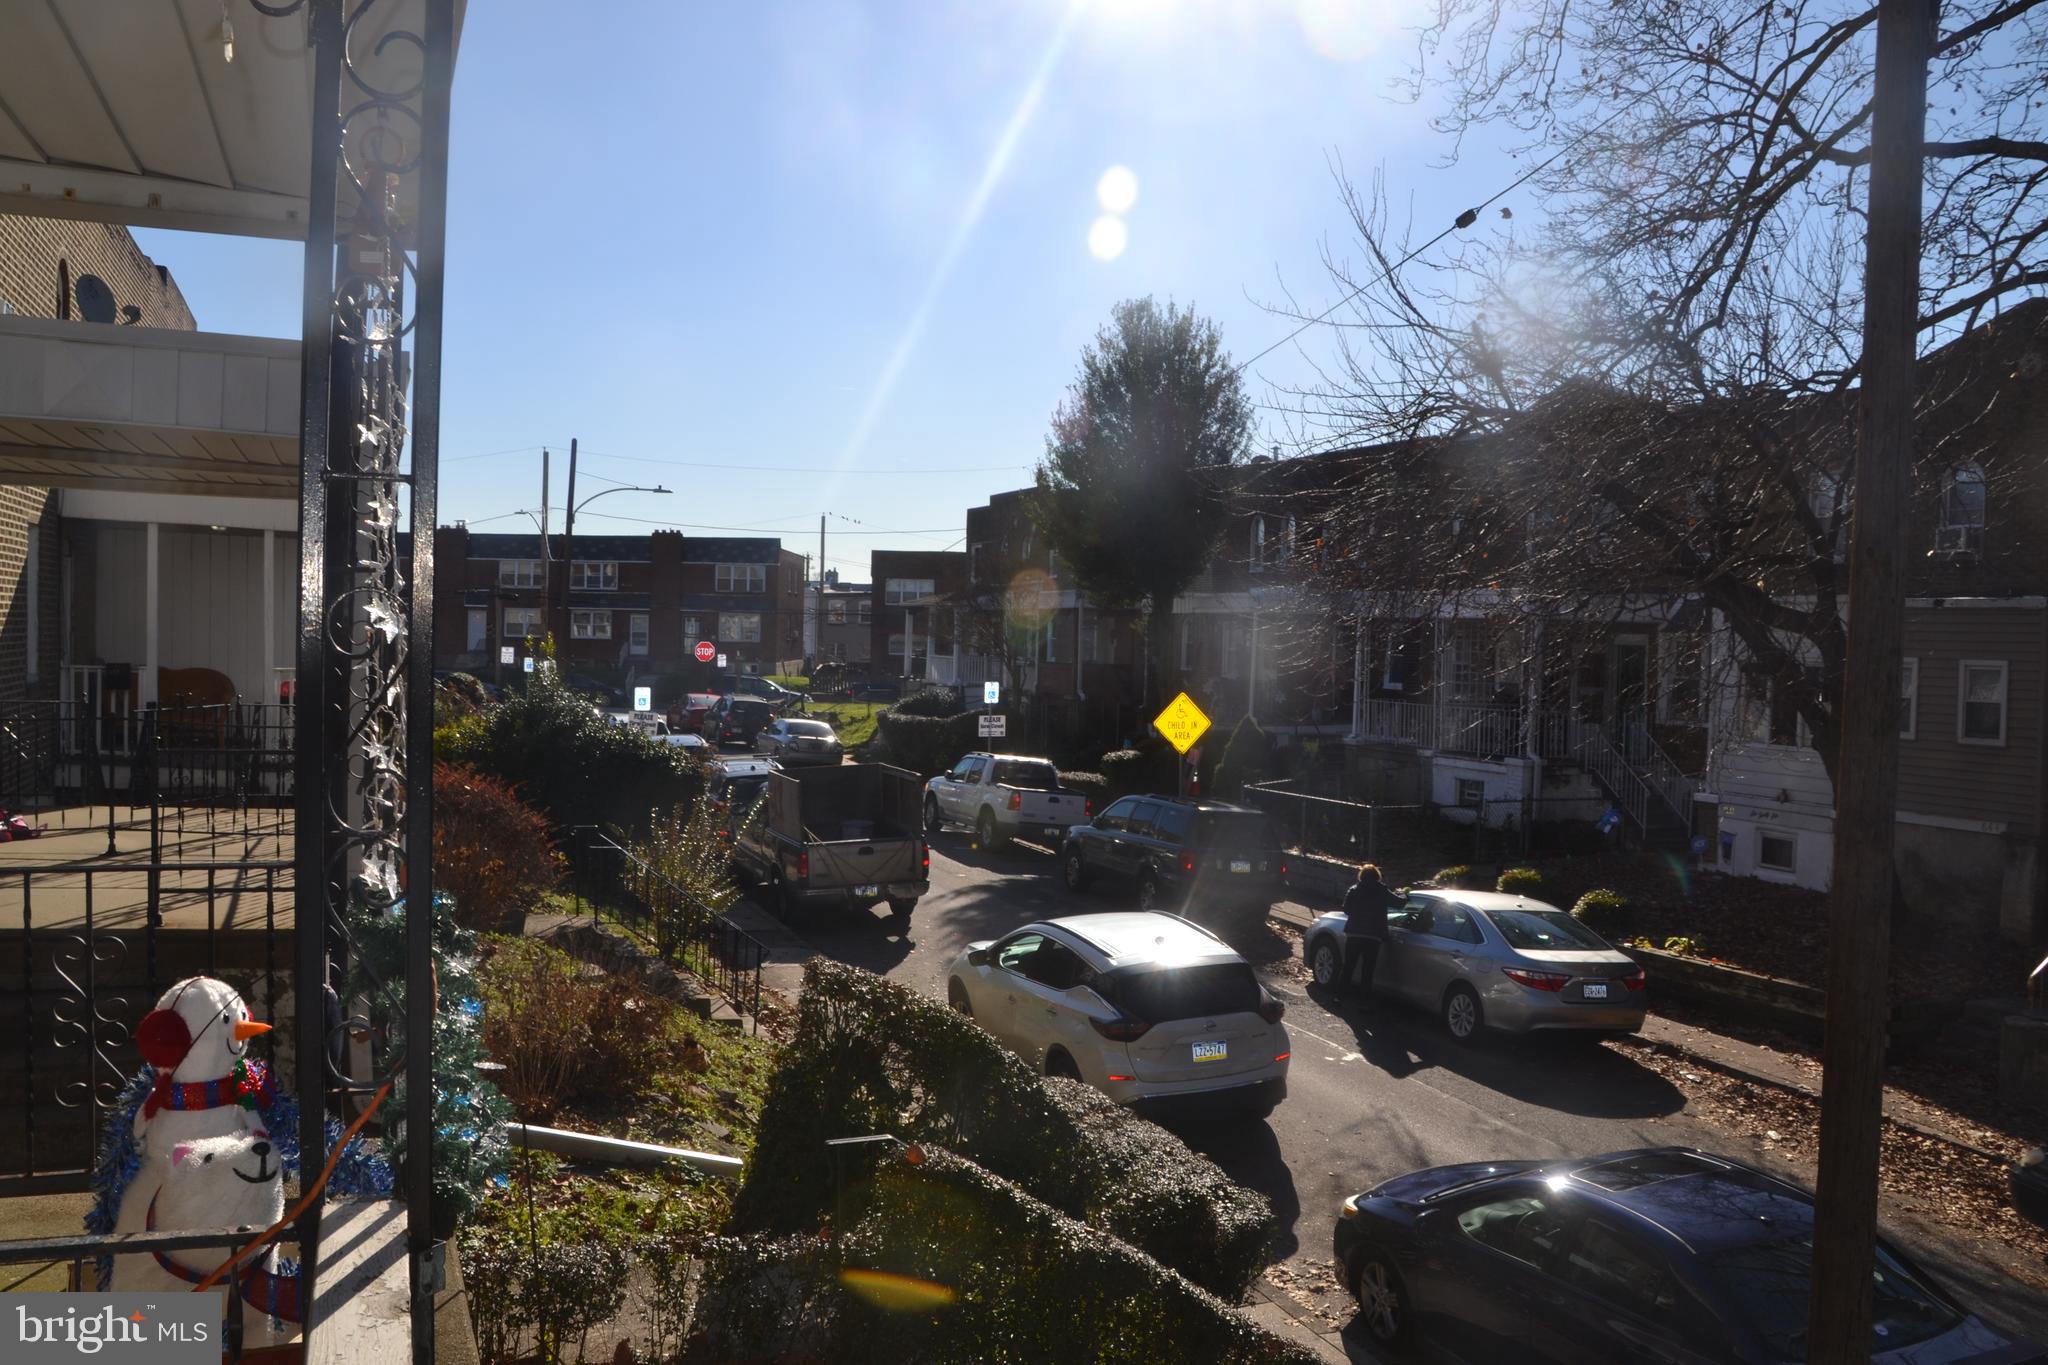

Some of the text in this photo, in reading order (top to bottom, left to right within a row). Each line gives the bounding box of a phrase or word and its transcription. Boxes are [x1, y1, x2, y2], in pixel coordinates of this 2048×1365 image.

[696, 647, 714, 656] STOP
[1167, 721, 1198, 730] CHILD IN
[1173, 731, 1191, 740] AREA
